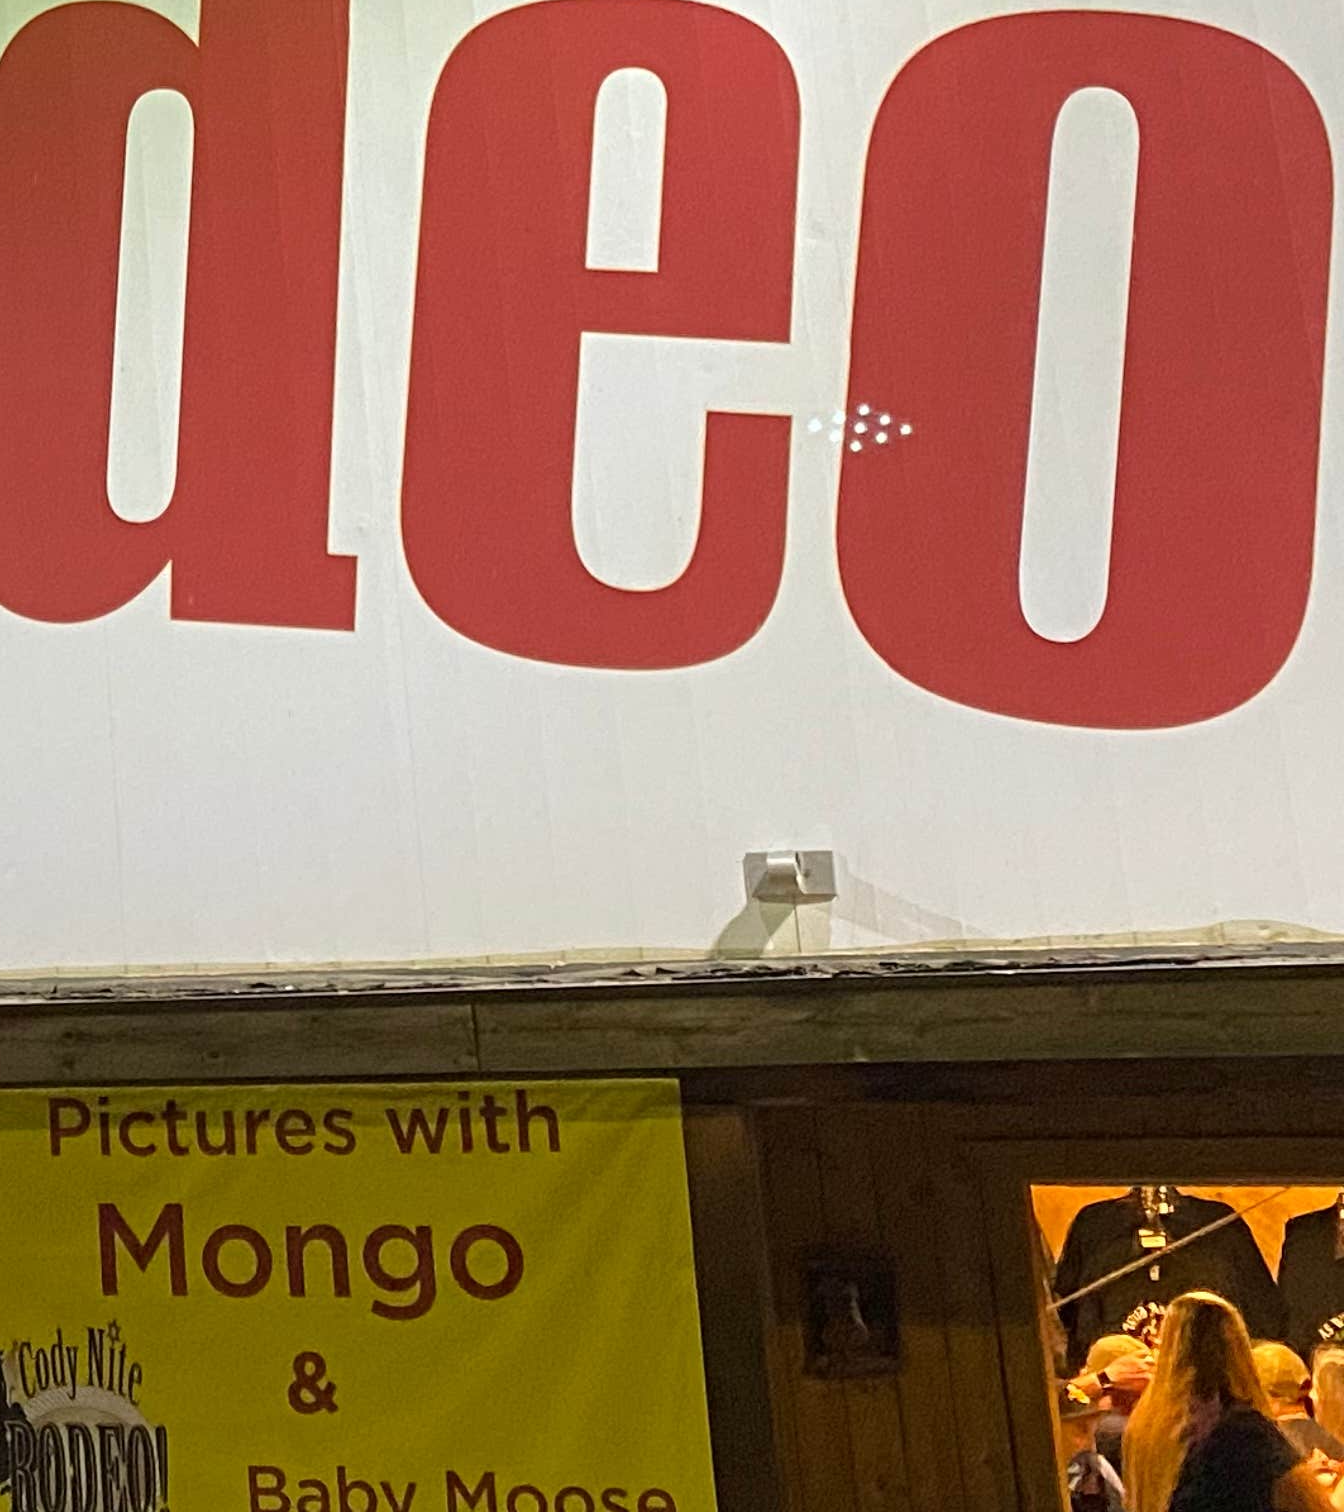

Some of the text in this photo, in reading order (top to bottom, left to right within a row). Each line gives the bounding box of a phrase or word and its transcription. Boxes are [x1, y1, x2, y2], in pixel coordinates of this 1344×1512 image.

[47, 1089, 561, 1157] Pictures with
[98, 1202, 525, 1321] Mongo
[18, 1320, 143, 1407] Cody Nite
[286, 1350, 339, 1415] &
[247, 1465, 677, 1512] Baby Moose
